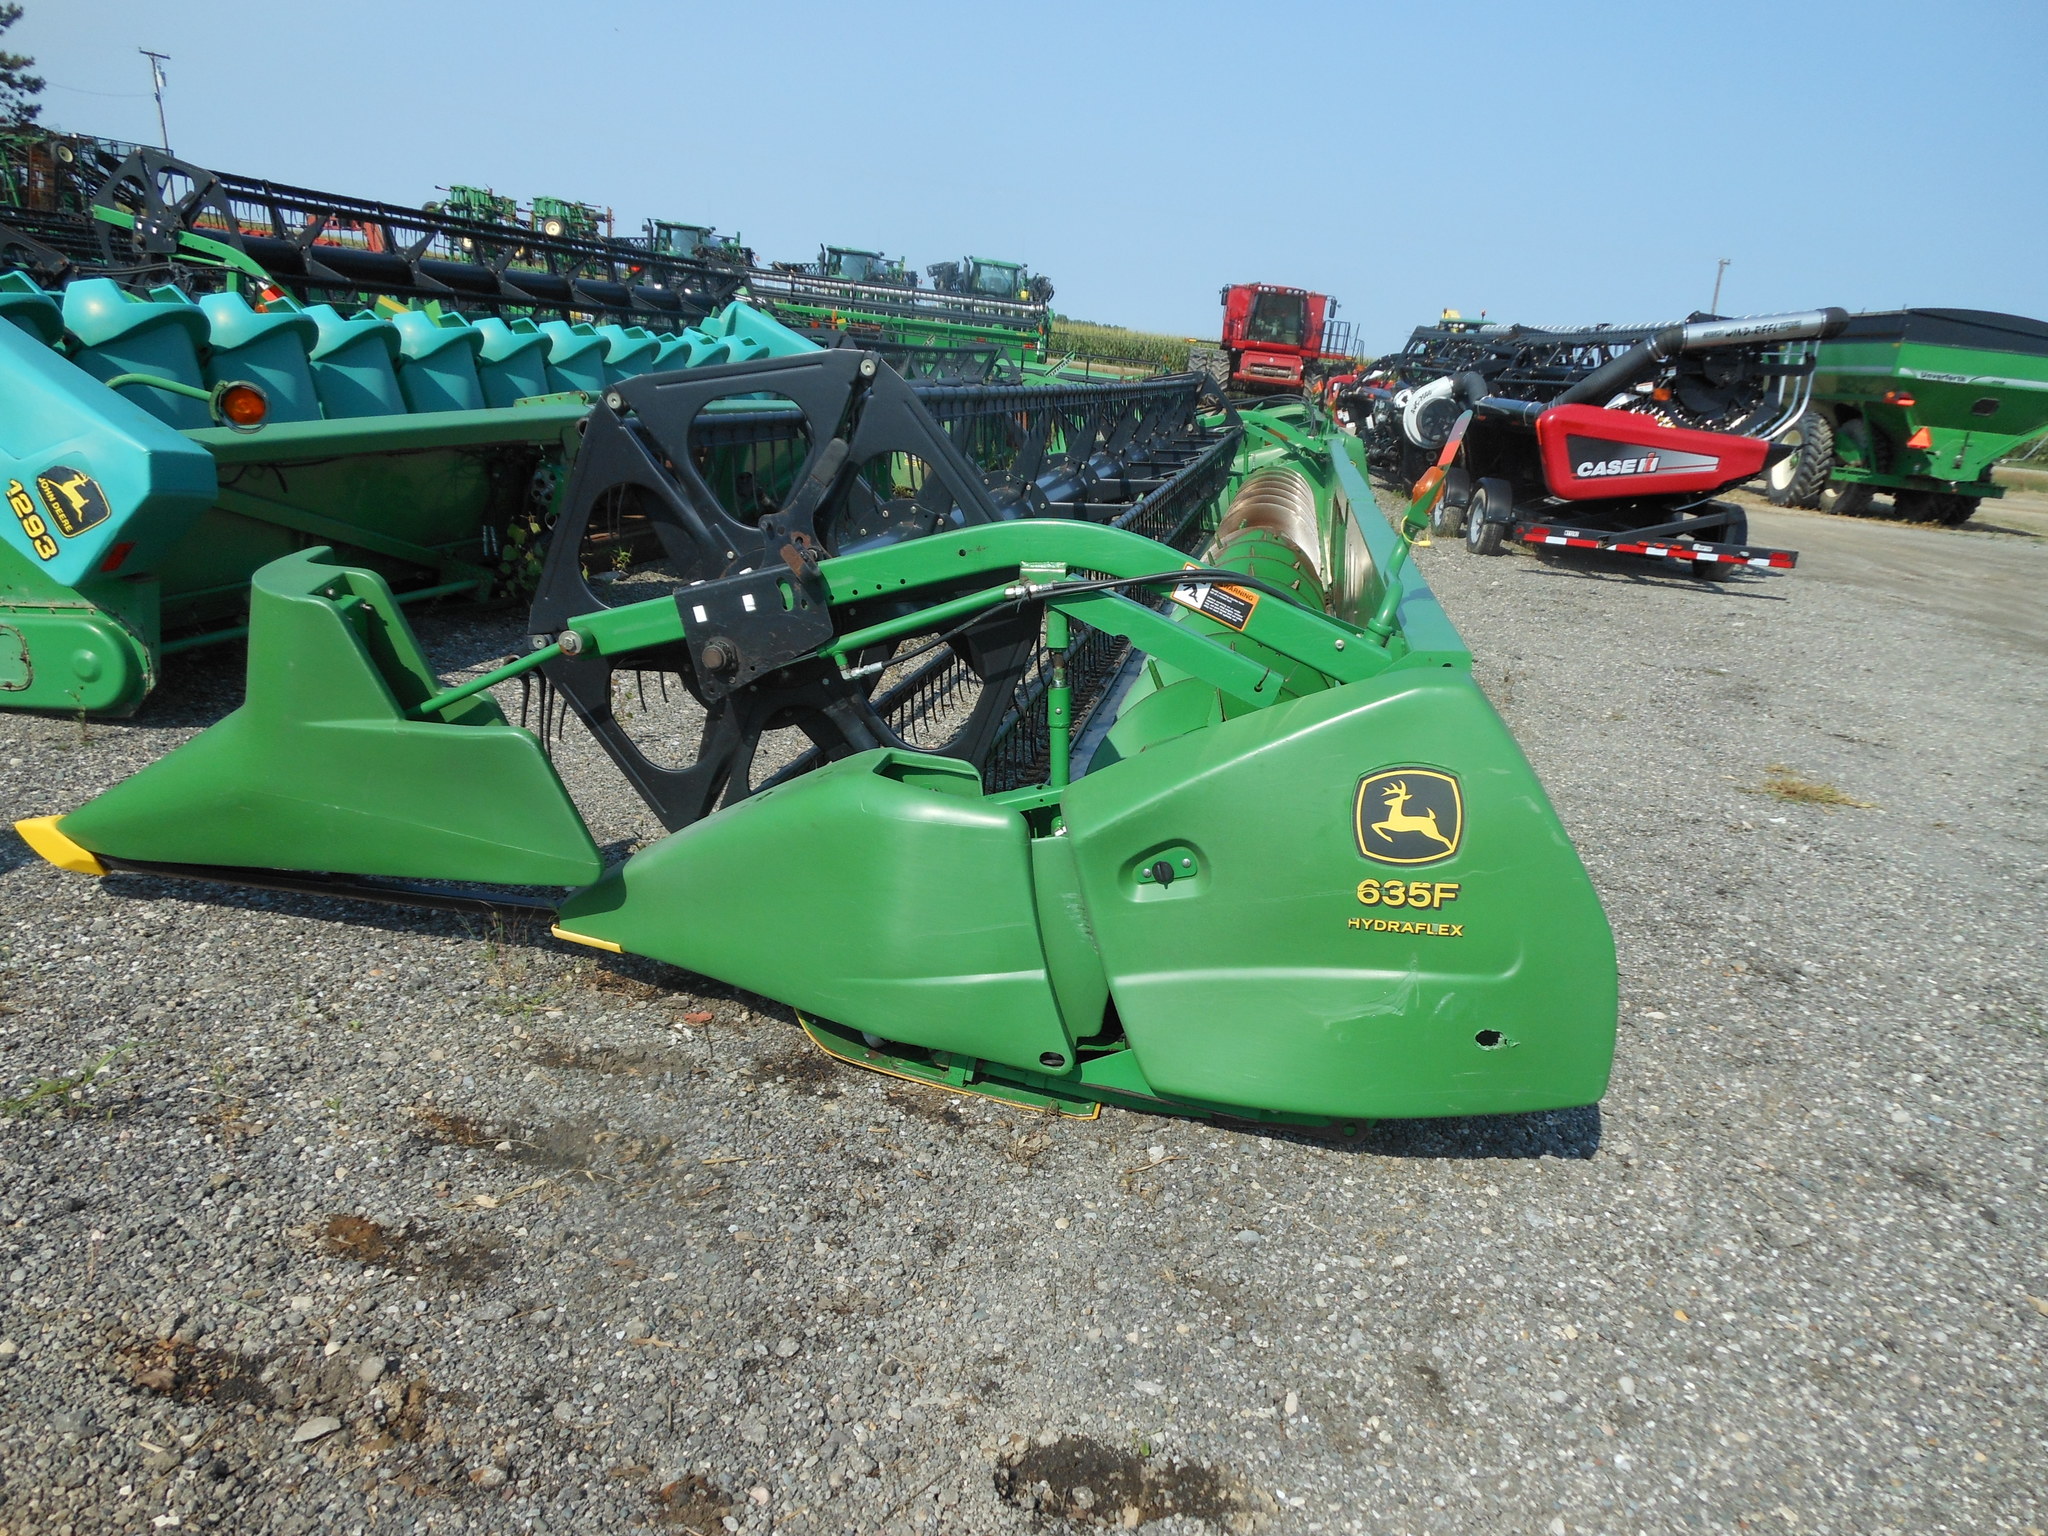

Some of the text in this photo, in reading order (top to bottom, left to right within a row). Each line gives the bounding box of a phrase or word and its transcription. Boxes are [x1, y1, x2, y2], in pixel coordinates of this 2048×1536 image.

[1576, 459, 1638, 478] CASE
[6, 479, 59, 561] 1293
[38, 477, 74, 533] JOHN DEERE
[1356, 878, 1461, 911] 635F
[1347, 917, 1464, 937] HYDRAFLEX
